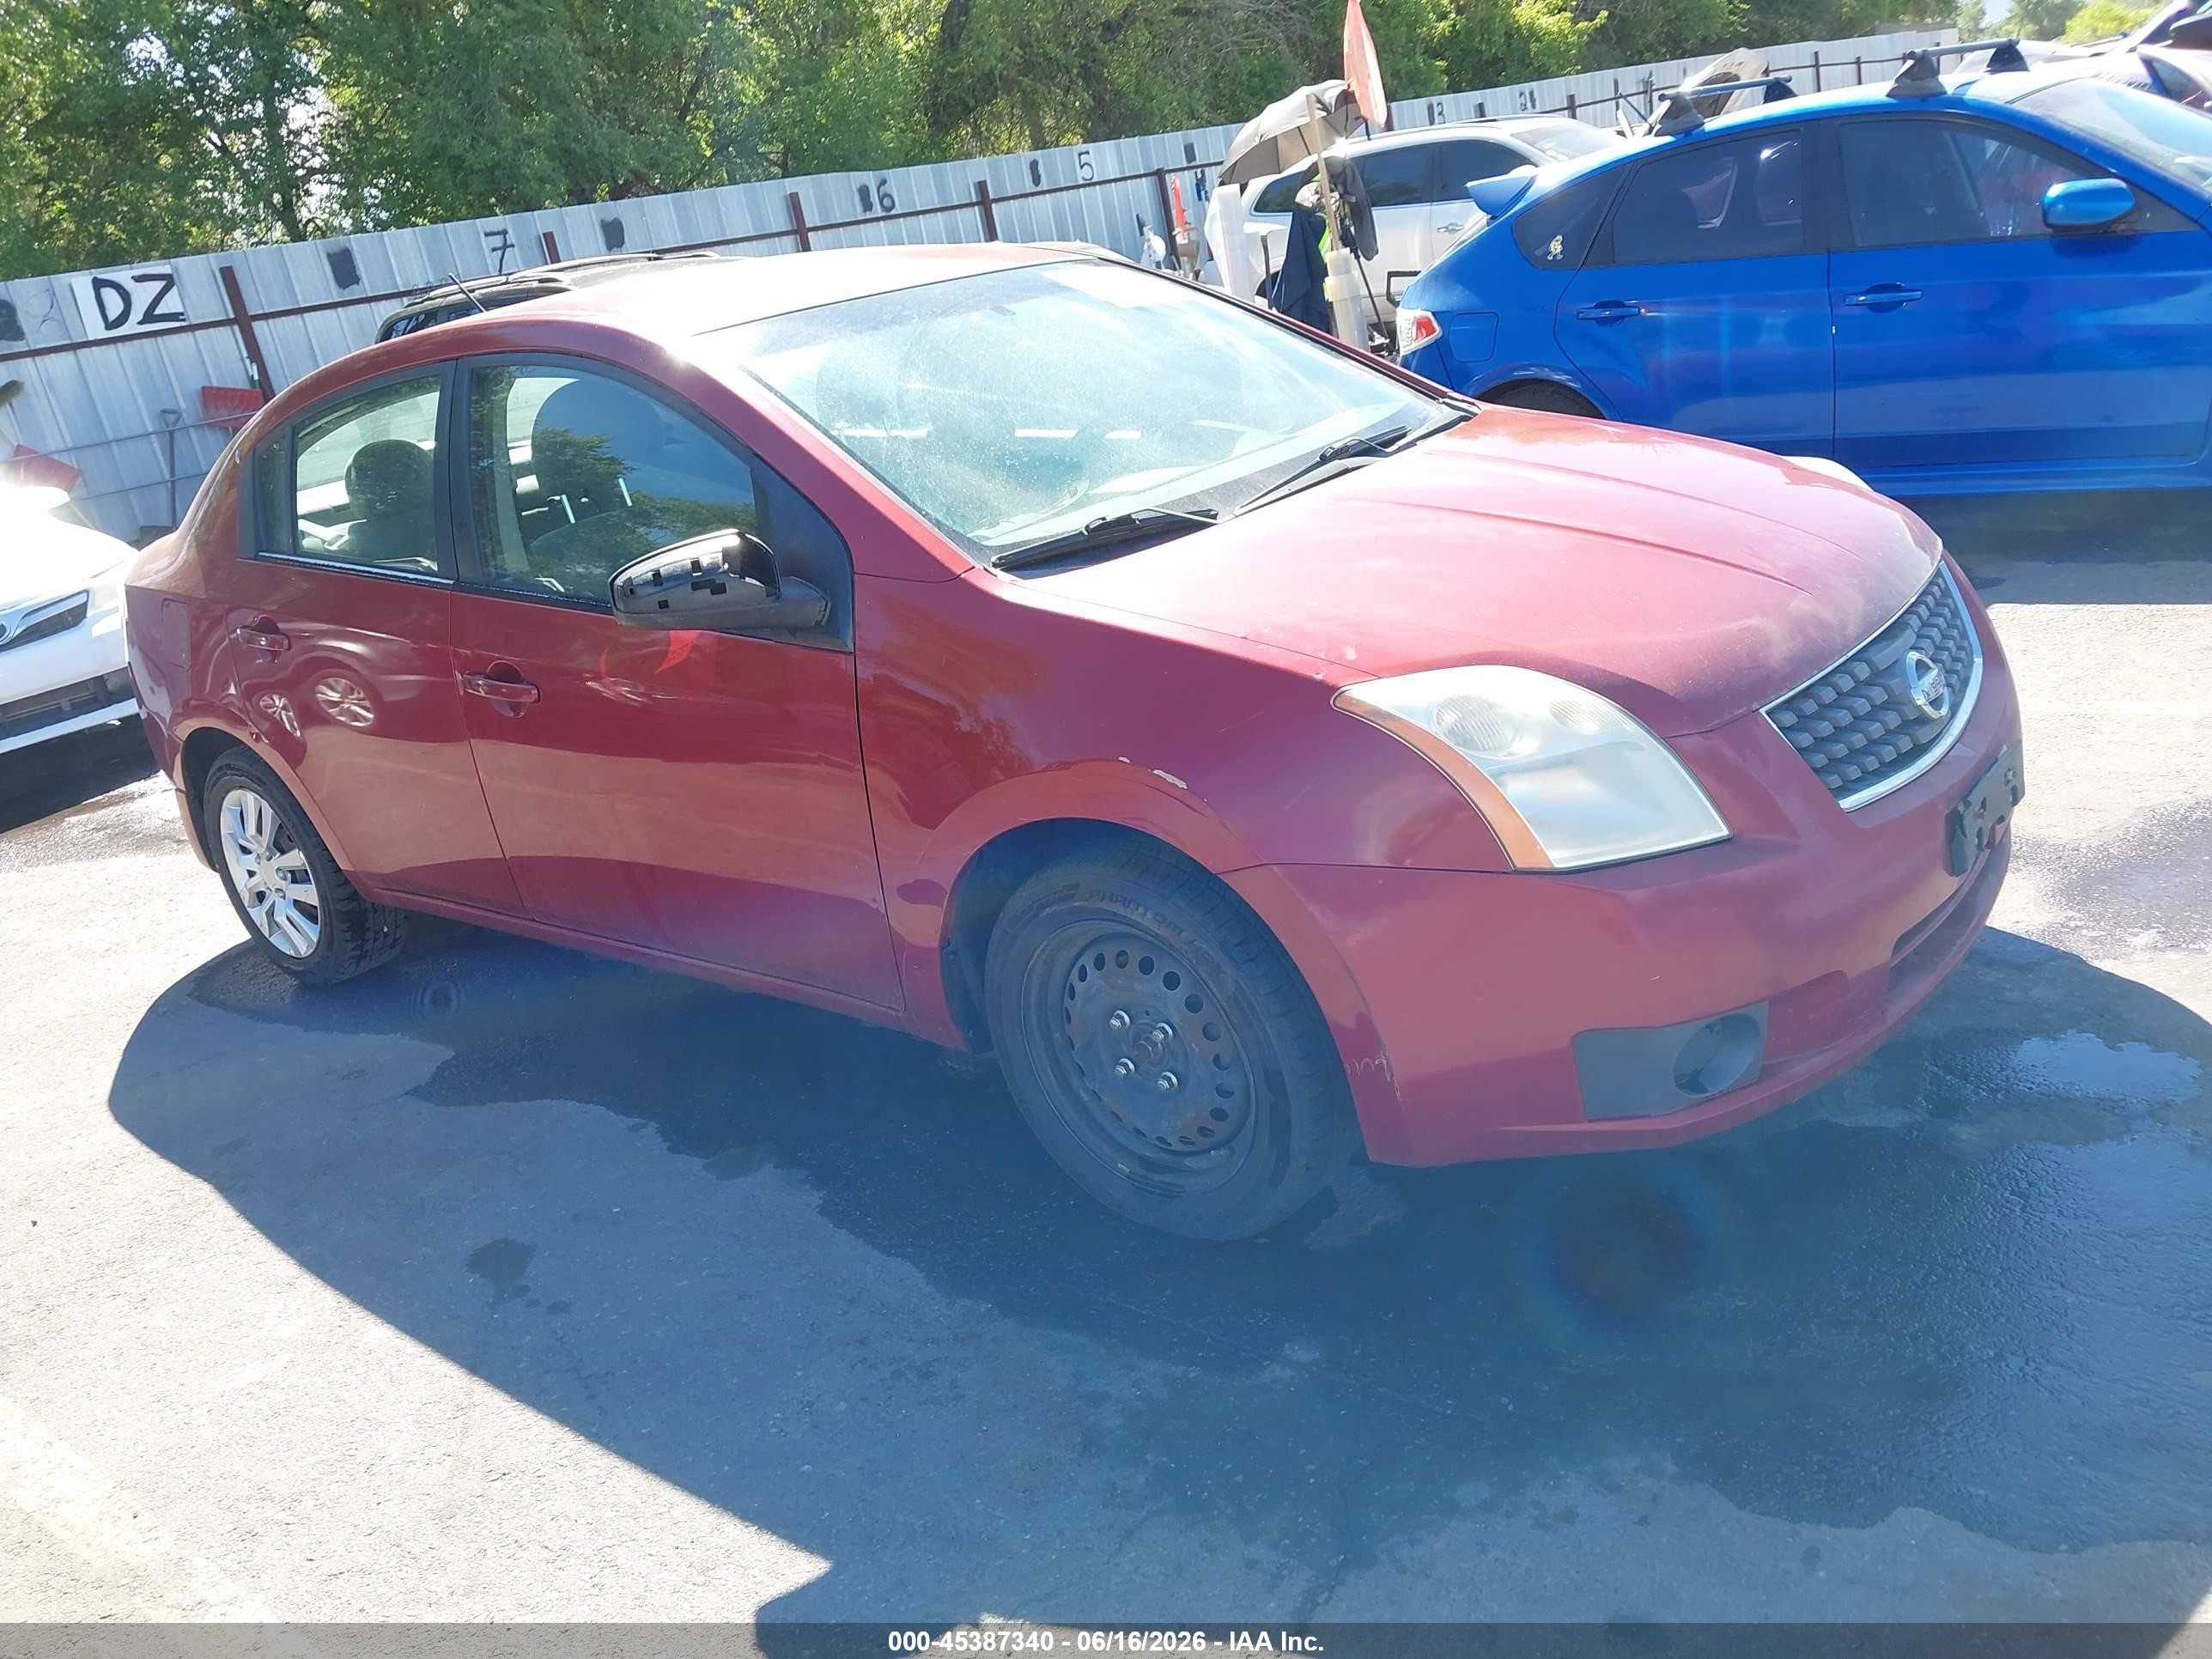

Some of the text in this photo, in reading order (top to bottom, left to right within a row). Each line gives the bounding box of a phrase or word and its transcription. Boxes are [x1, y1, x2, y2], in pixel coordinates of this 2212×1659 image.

[1078, 149, 1096, 182] 5
[876, 178, 896, 213] 6
[483, 228, 515, 276] 7
[91, 272, 186, 331] DZ
